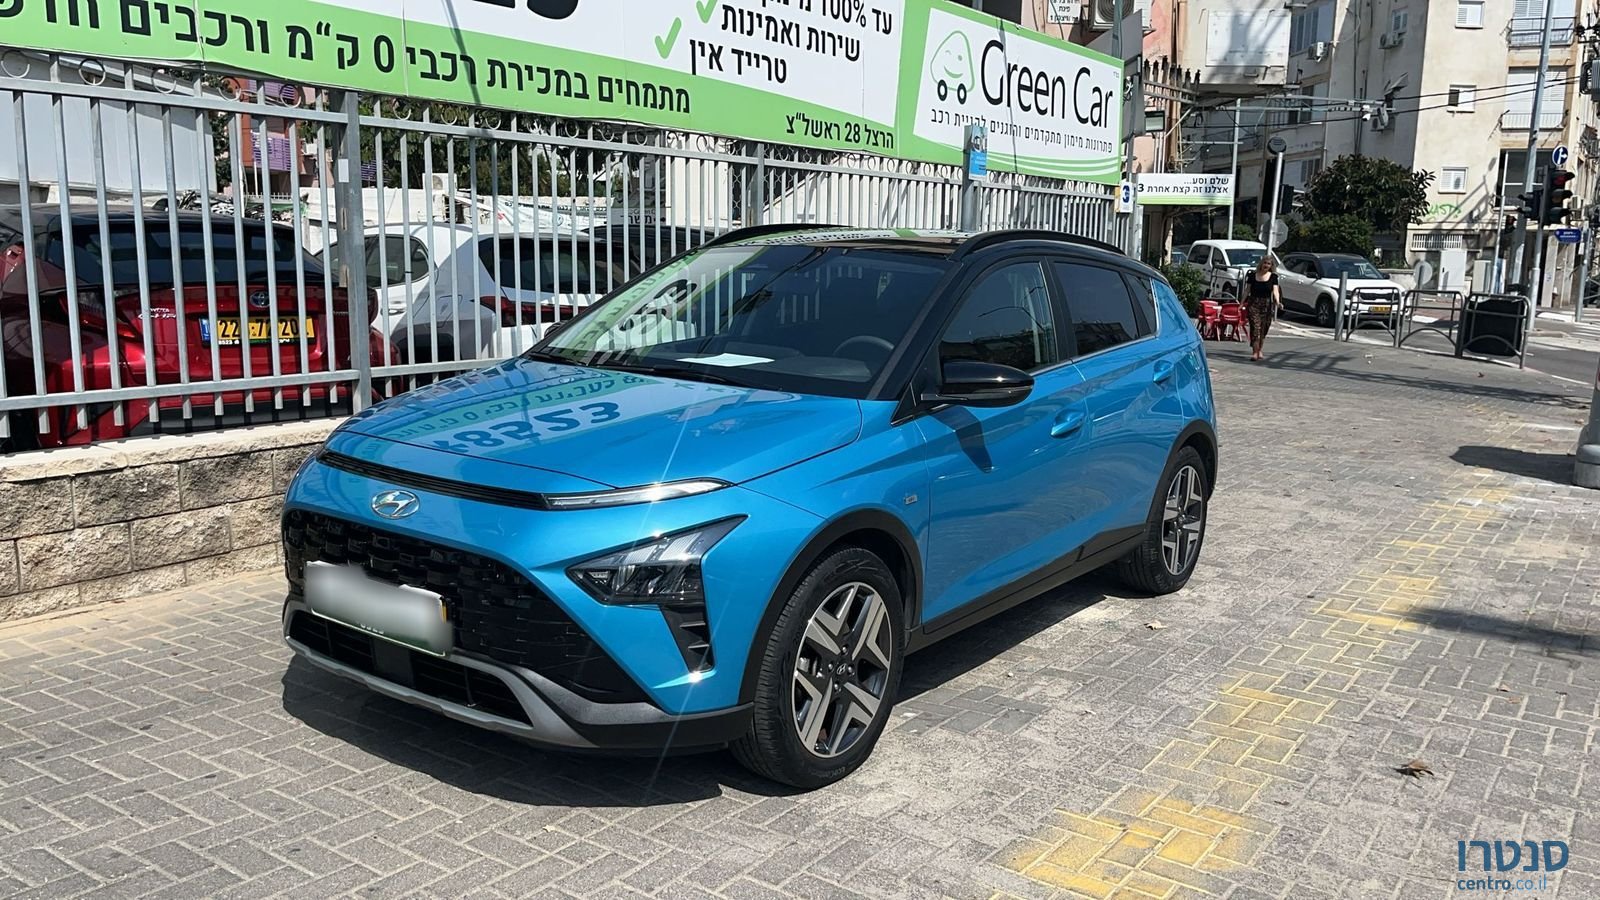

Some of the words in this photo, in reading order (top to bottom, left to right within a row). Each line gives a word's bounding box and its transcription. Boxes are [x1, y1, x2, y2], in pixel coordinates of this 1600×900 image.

[119, 0, 270, 54] ורכבים
[721, 4, 801, 48] ואמינות
[822, 0, 867, 27] 100%
[872, 8, 893, 35] עד
[373, 34, 395, 74] 0
[689, 39, 724, 76] אין
[806, 26, 860, 62] שירות
[405, 46, 477, 85] רכבי
[486, 58, 590, 100] במכירת
[731, 48, 787, 84] טרייד
[597, 75, 690, 114] מתמחים
[980, 39, 1066, 120] Green
[1073, 66, 1113, 129] Car
[930, 108, 950, 125] רכב
[844, 121, 861, 143] 28
[864, 123, 894, 149] הרצל
[1024, 126, 1062, 146] מתקדמים
[1063, 133, 1083, 149] מימון
[1085, 137, 1113, 153] פתרונות
[1146, 185, 1171, 193] אחרת
[1172, 185, 1190, 195] קצת
[1204, 184, 1229, 193] אצלנו
[1209, 176, 1229, 184] שלם
[620, 215, 653, 224] משר
